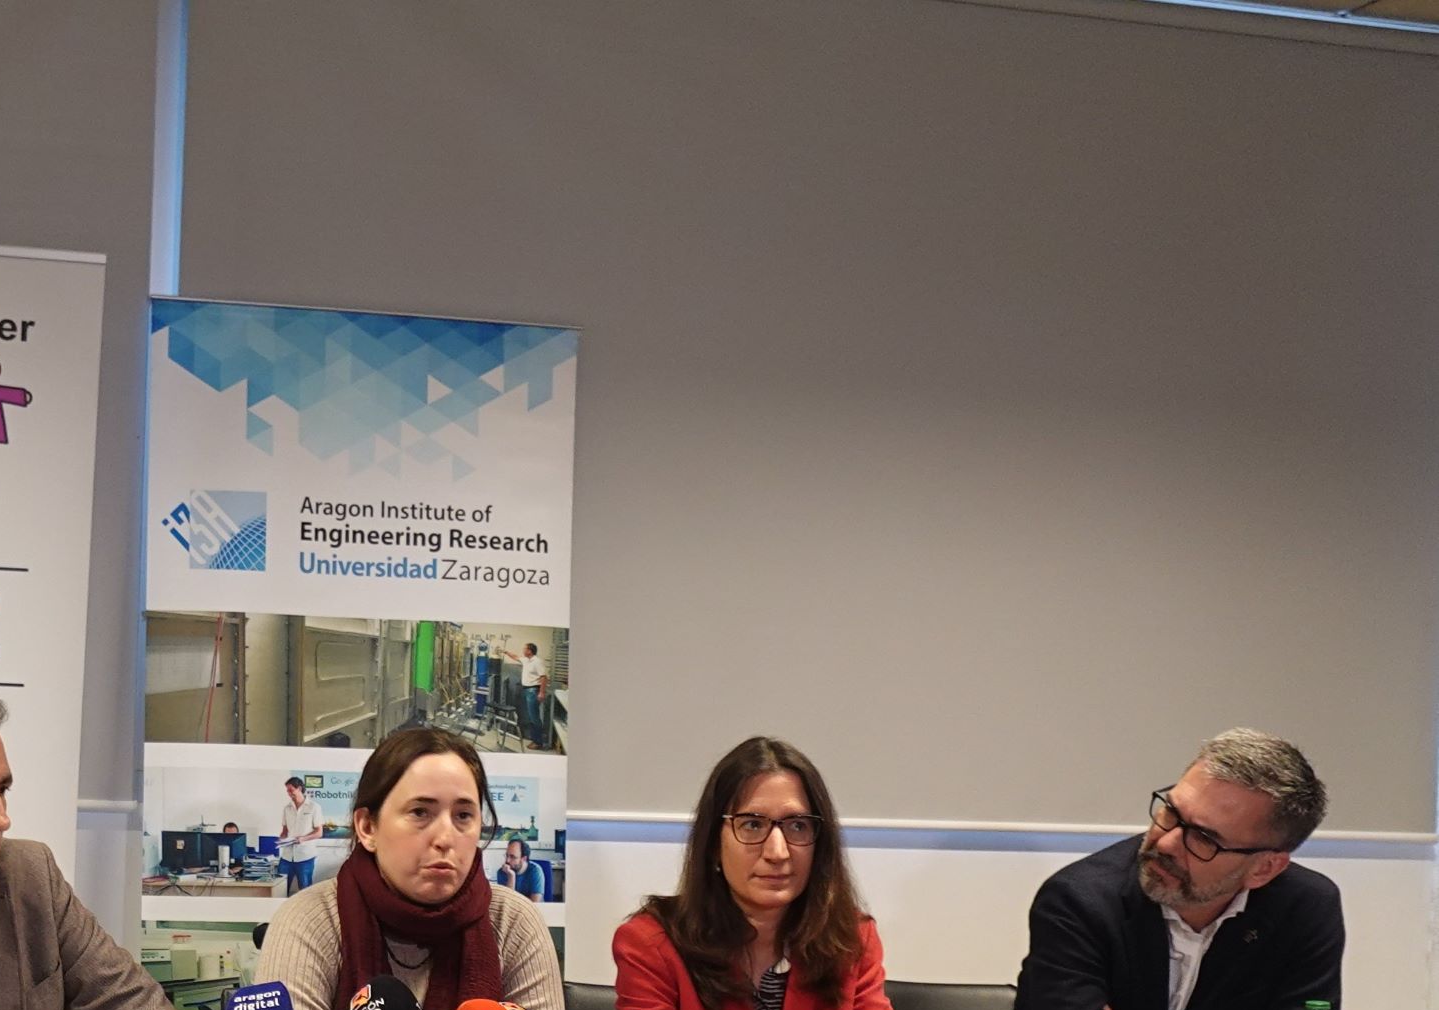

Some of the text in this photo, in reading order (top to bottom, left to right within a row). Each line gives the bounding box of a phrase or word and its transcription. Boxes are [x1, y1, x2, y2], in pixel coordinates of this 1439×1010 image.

[300, 497, 492, 523] Aragon Institute of
[300, 522, 549, 553] Engineering Research
[299, 552, 550, 588] Universidad Zaragoza
[234, 990, 281, 1003] aragon
